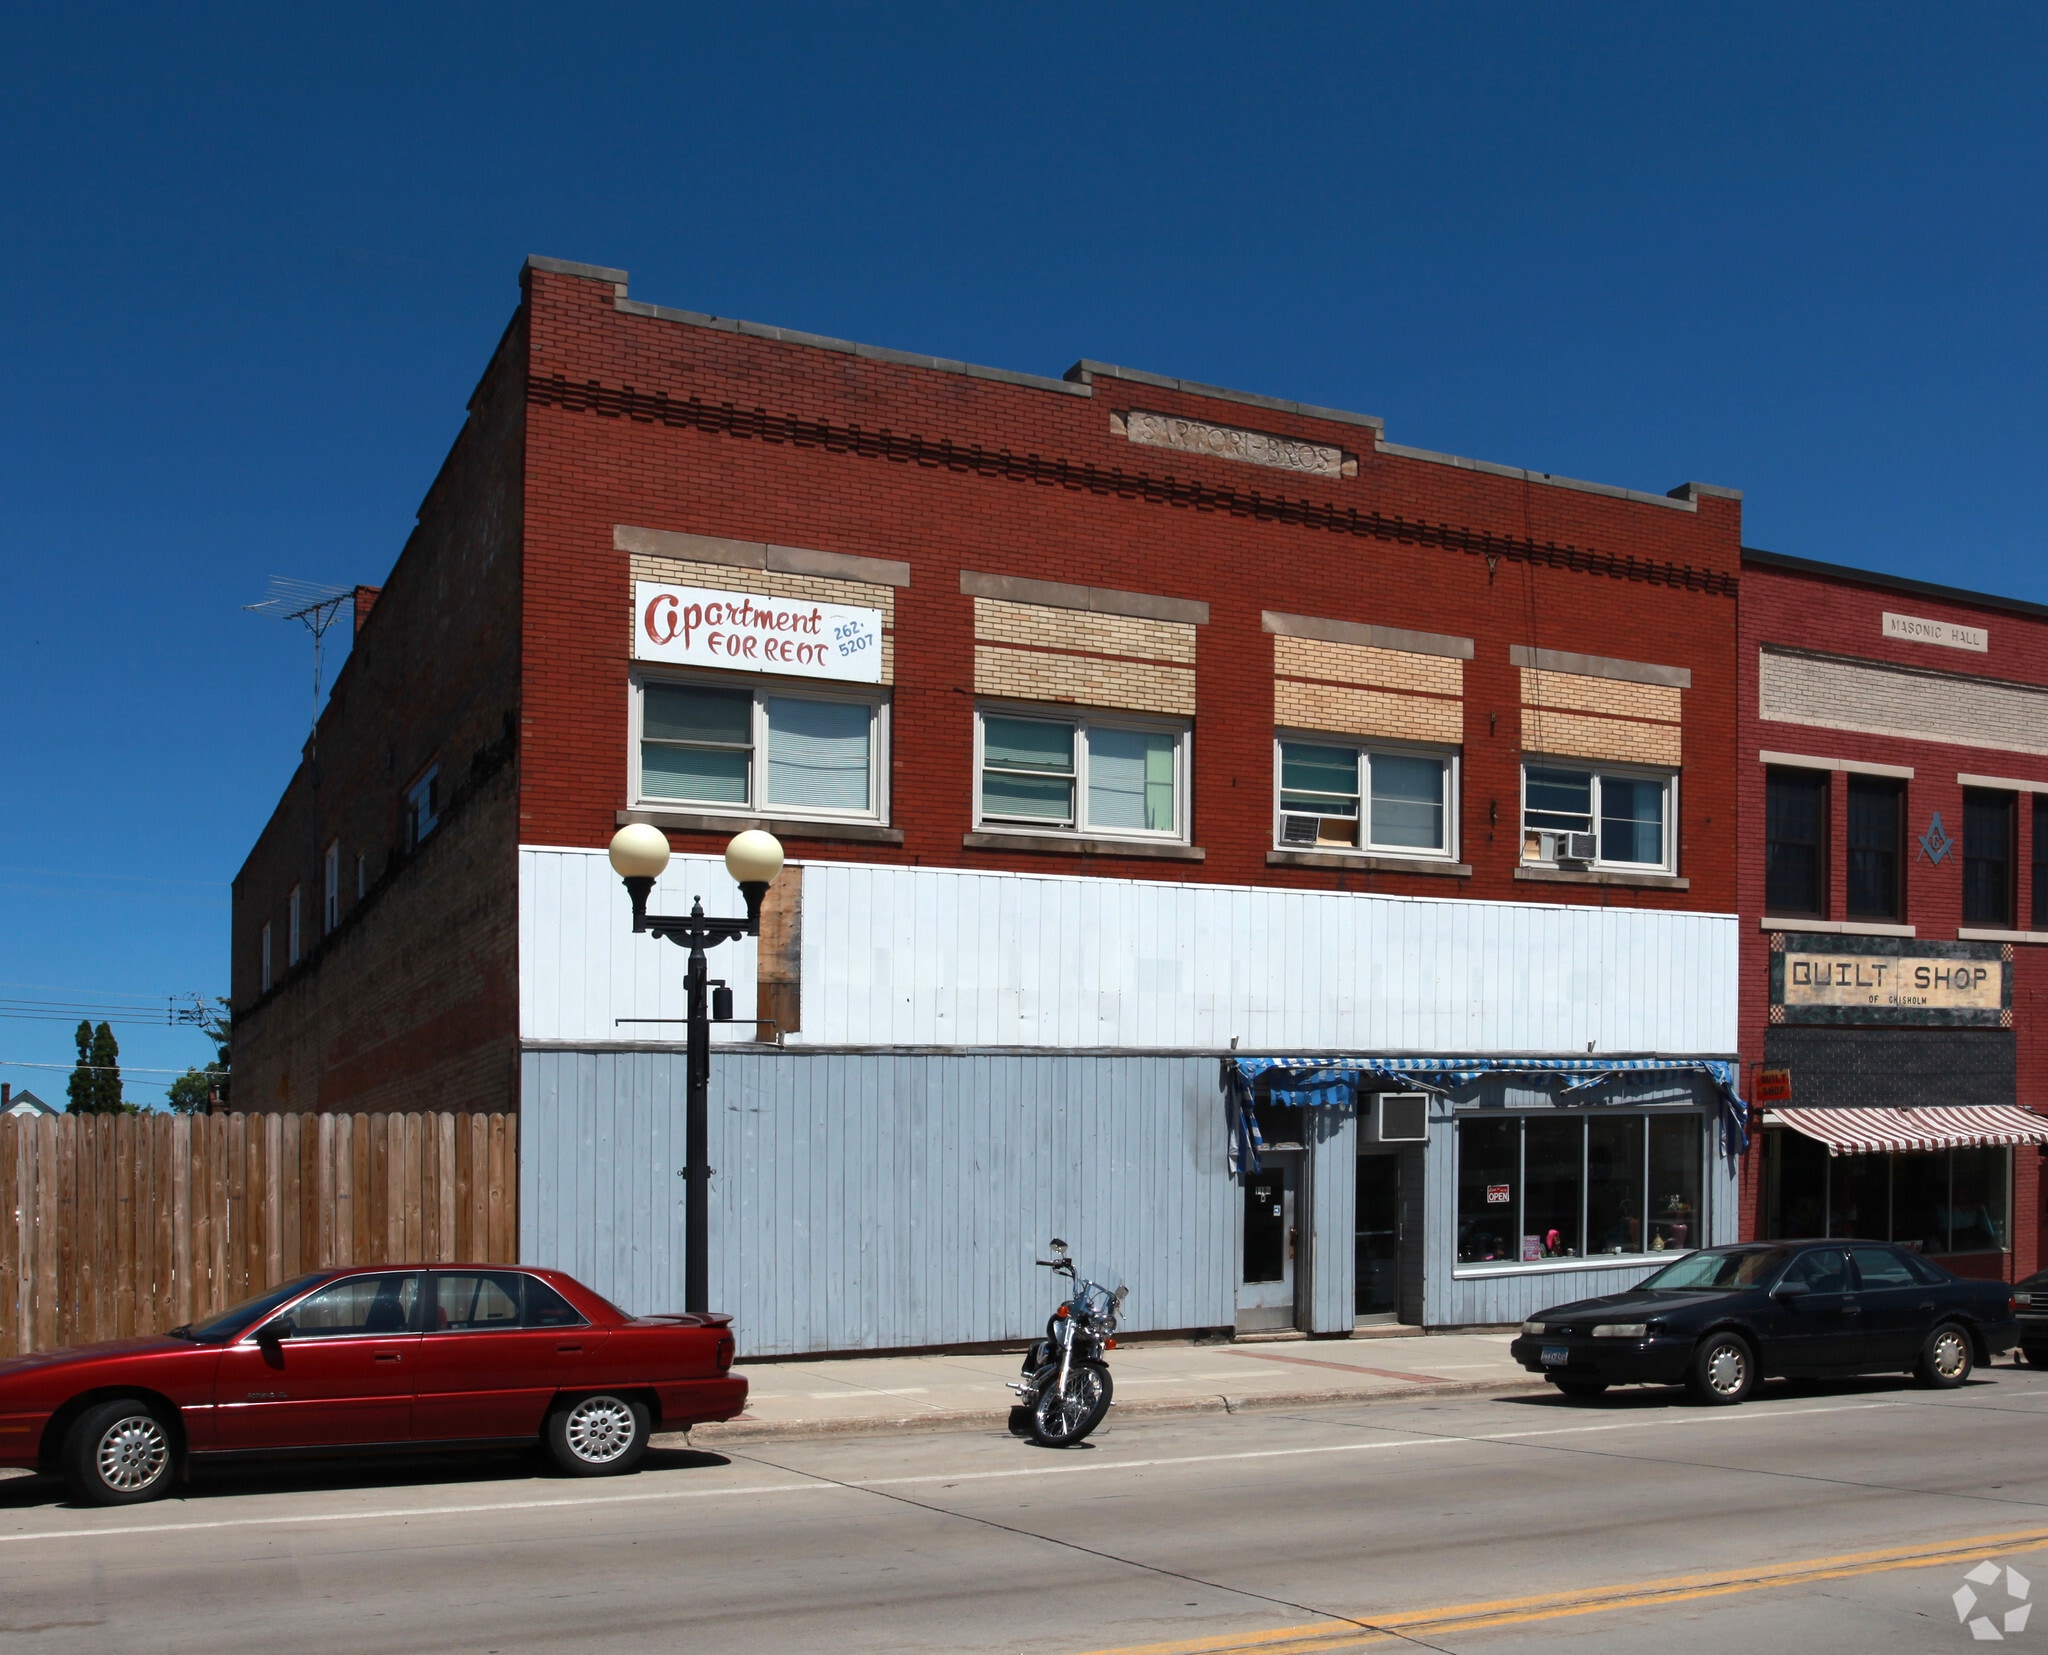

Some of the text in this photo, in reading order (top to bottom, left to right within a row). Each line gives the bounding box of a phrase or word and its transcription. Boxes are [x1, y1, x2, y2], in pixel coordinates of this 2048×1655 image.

[1891, 619, 1980, 646] MASONIC HALL
[707, 631, 829, 667] FOR RENT
[839, 633, 873, 657] 5207
[1793, 961, 1987, 990] QUILT SHOP
[1869, 995, 1927, 1005] OF CHISHOLM
[1760, 1073, 1787, 1084] QUILT
[1763, 1085, 1785, 1096] SHOP
[1488, 1193, 1508, 1201] OPEN
